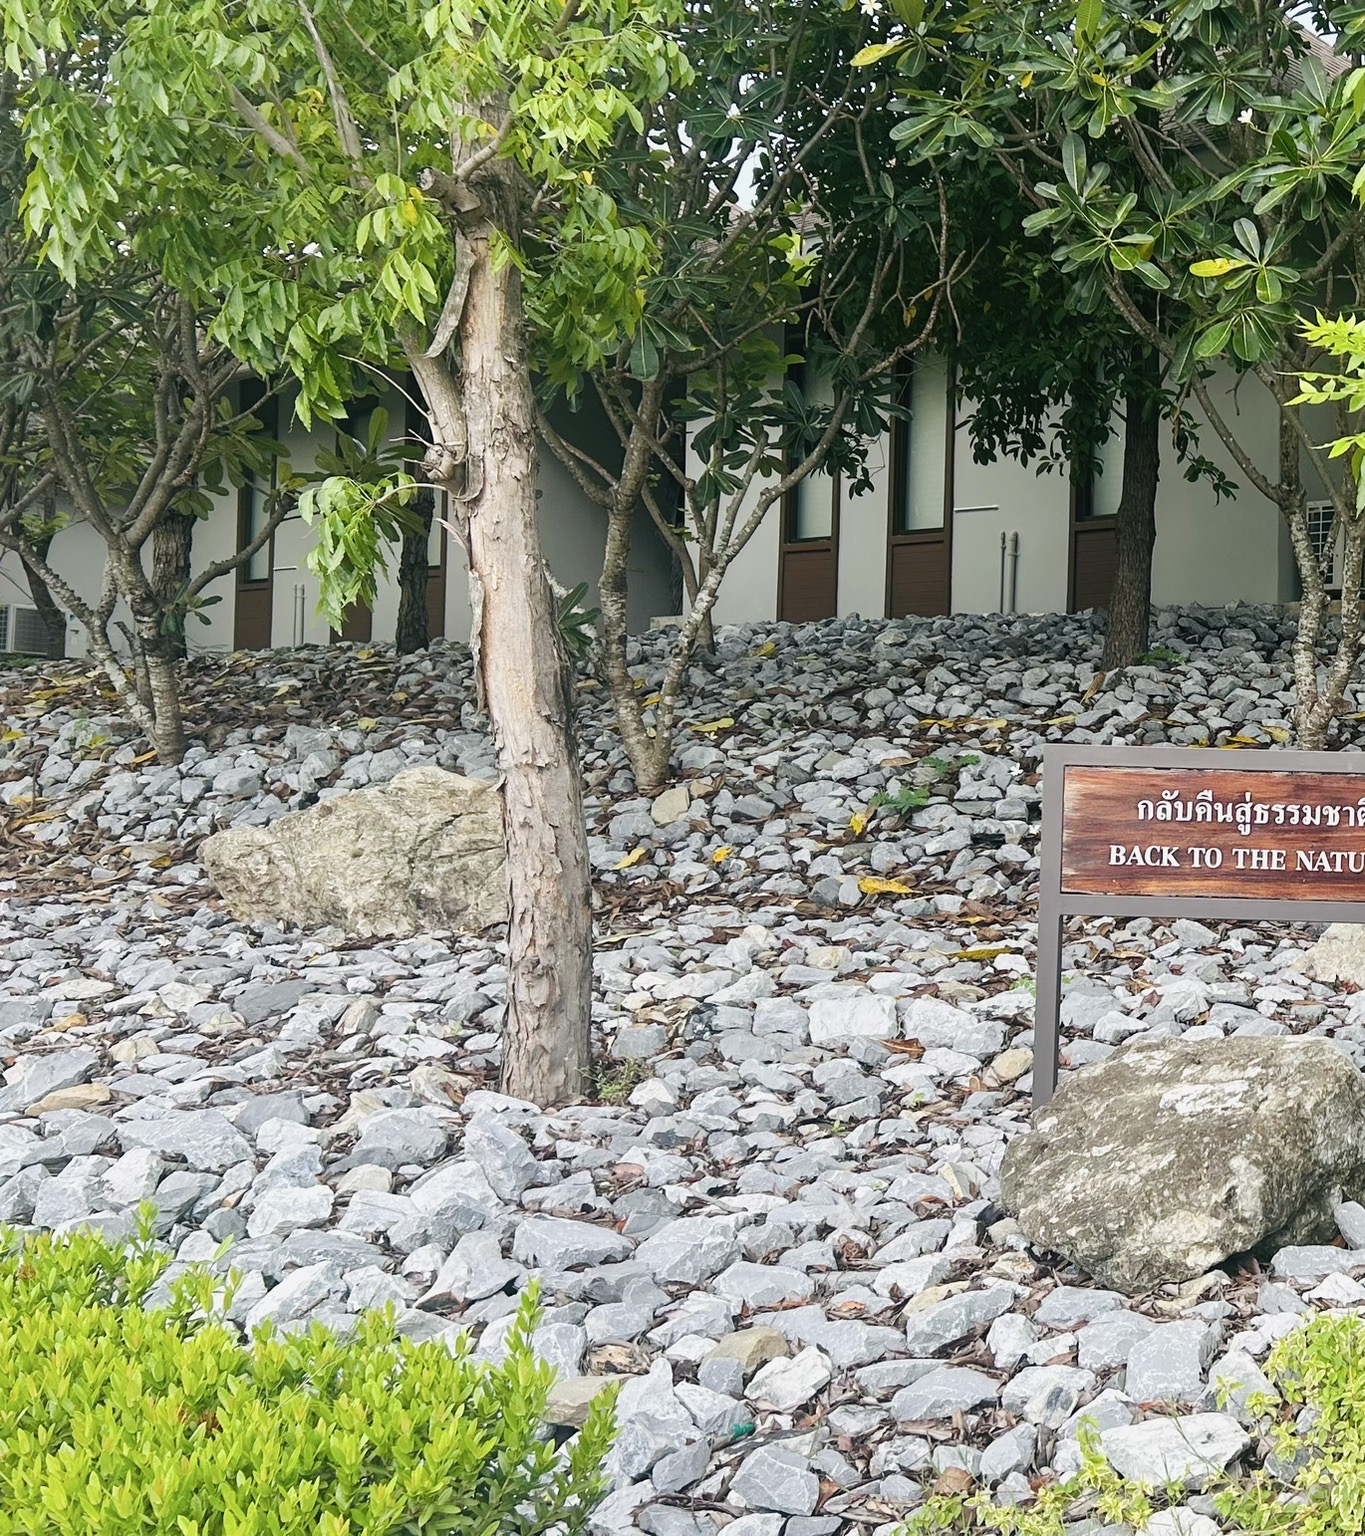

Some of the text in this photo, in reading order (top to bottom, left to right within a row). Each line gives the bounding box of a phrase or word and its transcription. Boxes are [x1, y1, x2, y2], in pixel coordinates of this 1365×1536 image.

[1108, 845, 1181, 868] BACK
[1187, 847, 1223, 869] TO
[1231, 848, 1287, 871] THE
